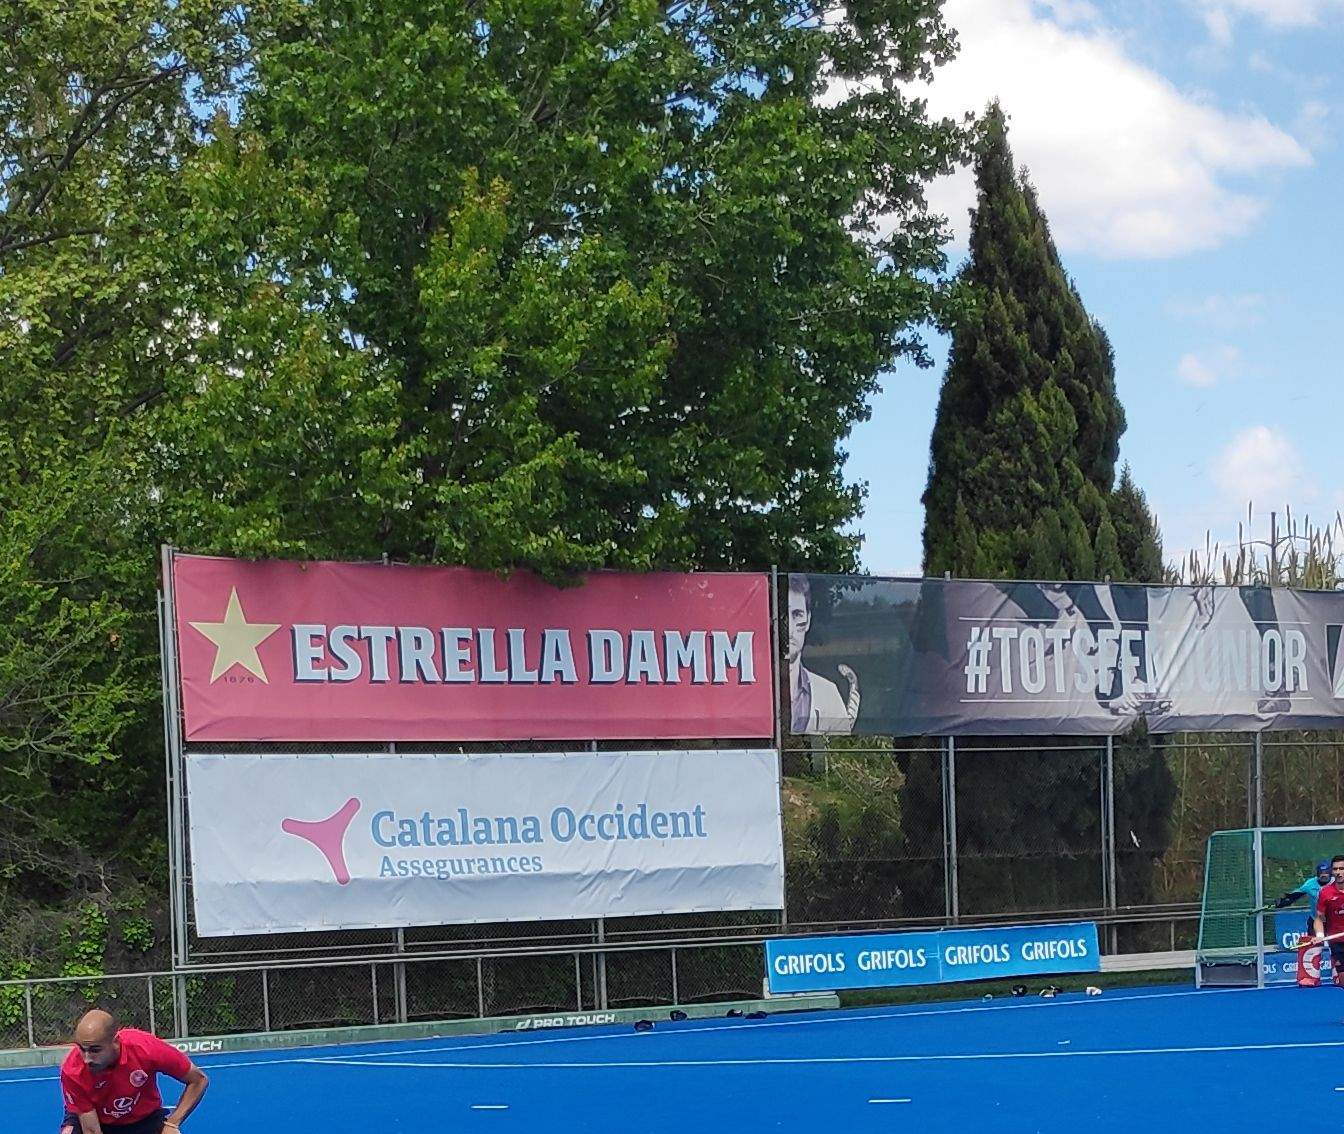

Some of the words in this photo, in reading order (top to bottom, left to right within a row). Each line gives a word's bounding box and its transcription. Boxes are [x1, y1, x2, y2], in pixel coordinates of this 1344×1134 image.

[291, 623, 579, 685] ESTRELLA
[588, 627, 757, 686] DAMM
[370, 806, 543, 849] Catalana
[550, 802, 708, 844] Occident
[378, 852, 544, 882] Assegurances
[773, 952, 845, 976] GRIFOLS
[857, 947, 927, 972] GRIFOLS
[944, 943, 1010, 966] GRIFOLS
[1021, 938, 1087, 962] GRIFOLS
[533, 1017, 564, 1029] PRO
[566, 1013, 616, 1026] TOUCH
[173, 1040, 224, 1052] OUCH
